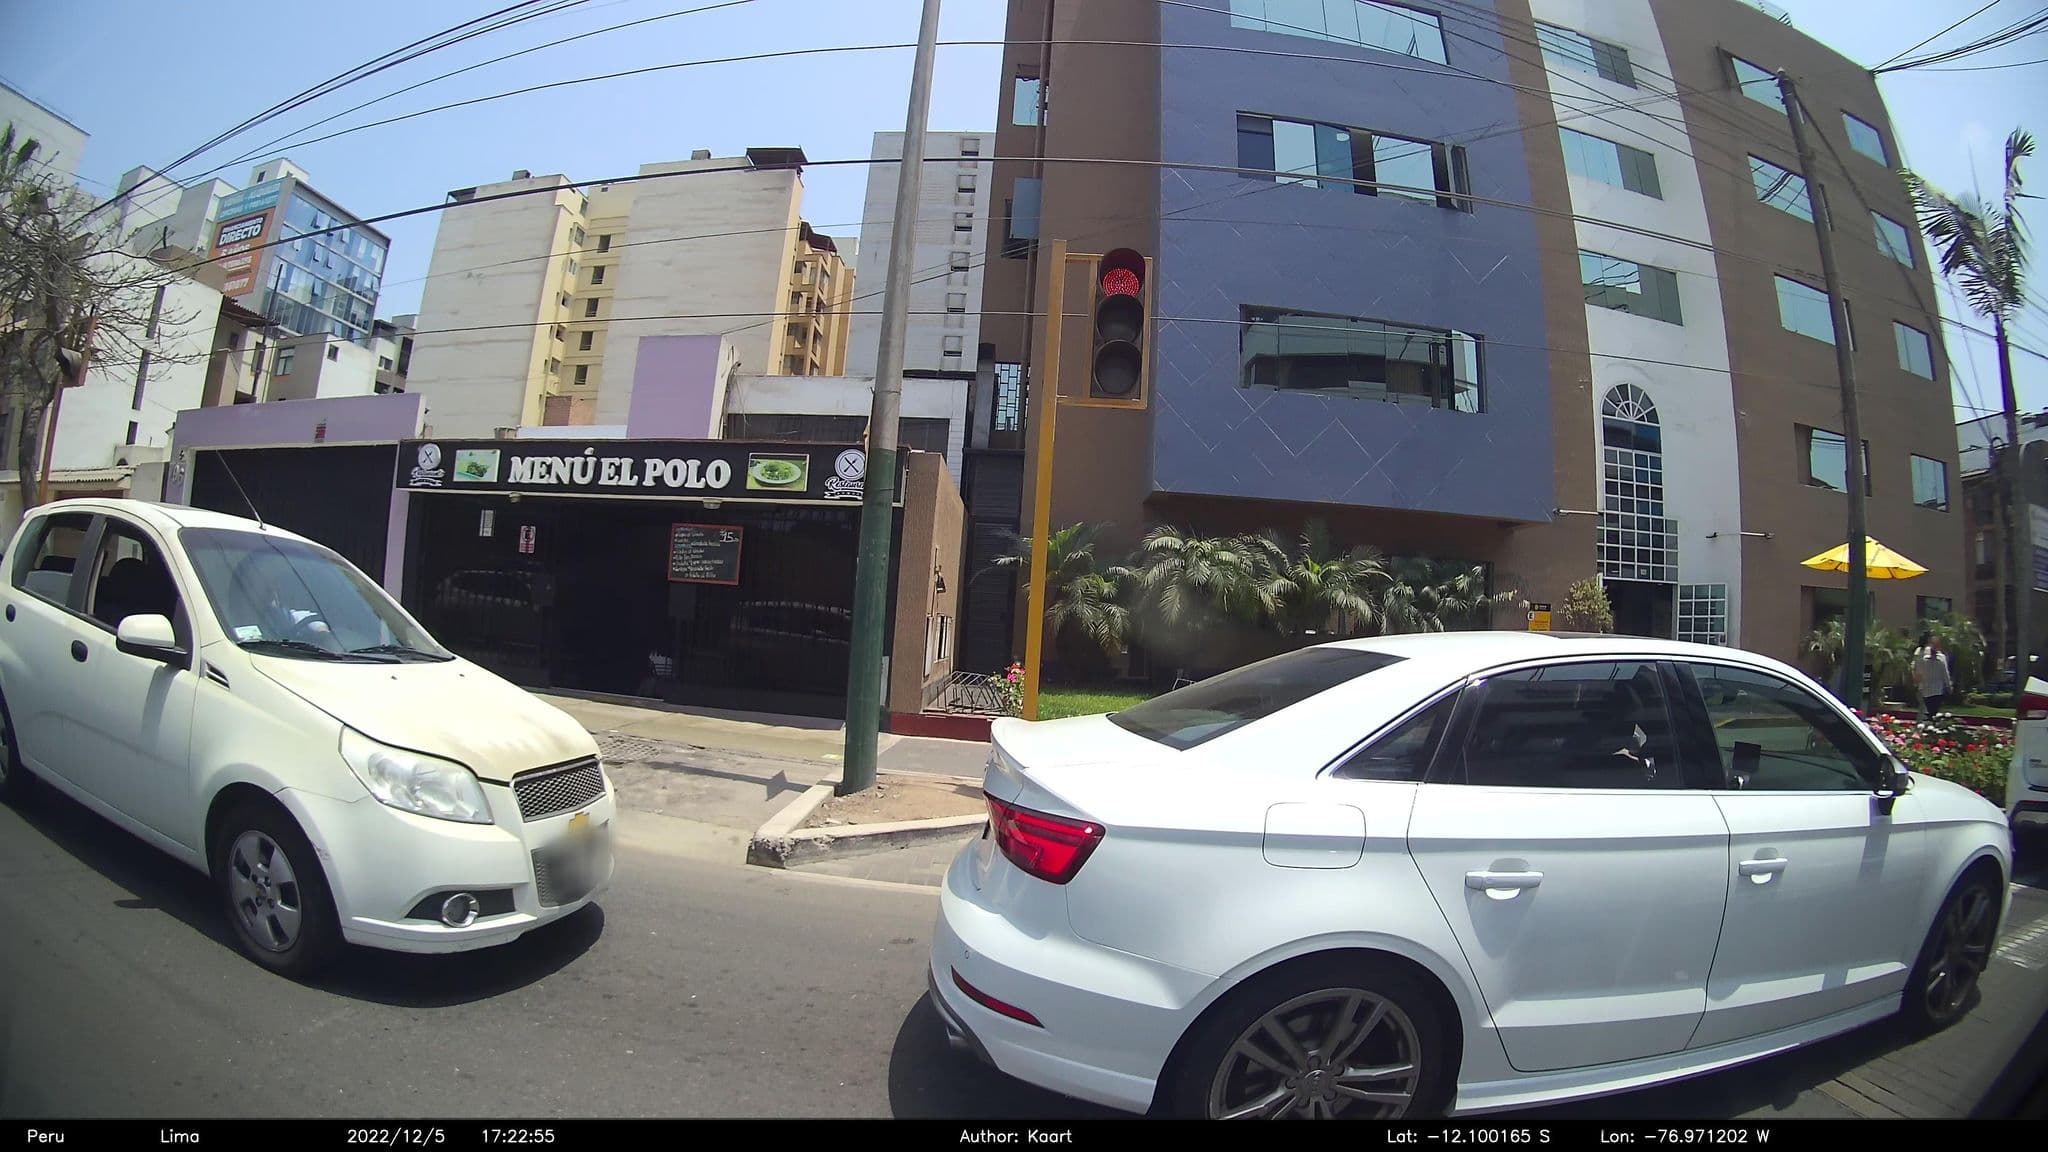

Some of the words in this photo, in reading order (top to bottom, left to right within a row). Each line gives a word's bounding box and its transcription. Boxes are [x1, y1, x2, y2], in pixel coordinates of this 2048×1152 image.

[219, 224, 261, 245] DIRECTO
[508, 447, 597, 484] MENÚ
[598, 458, 638, 486] EL
[643, 458, 731, 489] POLO
